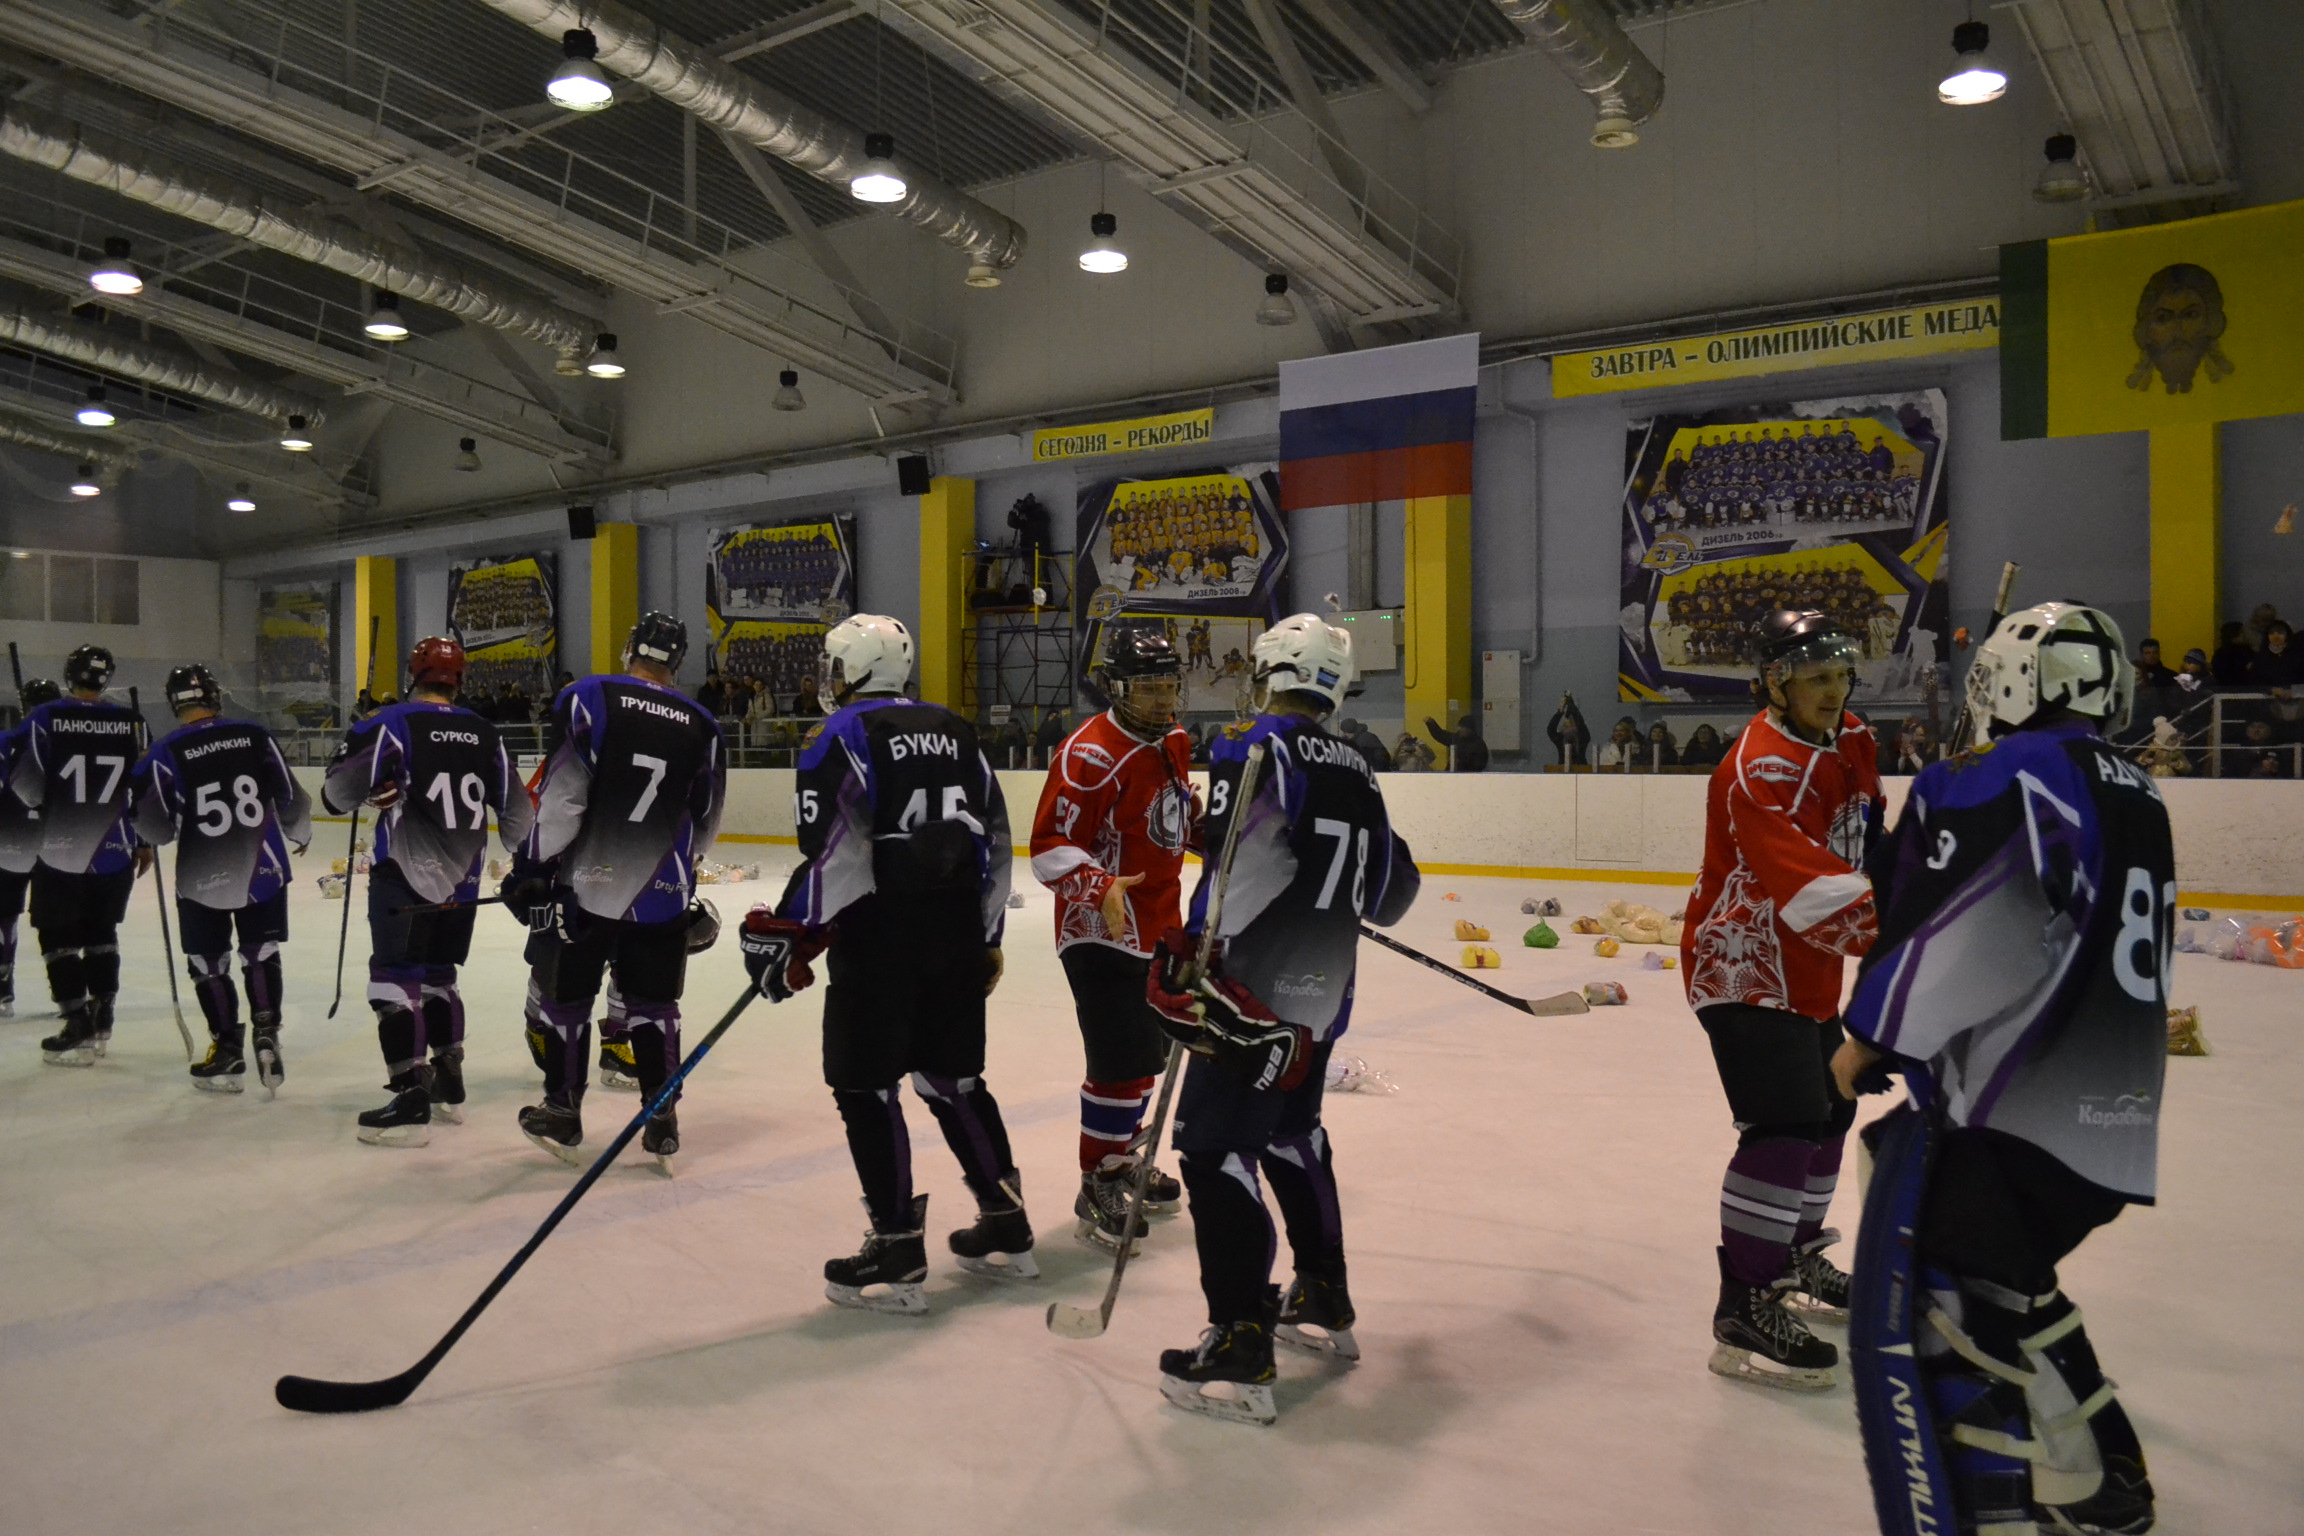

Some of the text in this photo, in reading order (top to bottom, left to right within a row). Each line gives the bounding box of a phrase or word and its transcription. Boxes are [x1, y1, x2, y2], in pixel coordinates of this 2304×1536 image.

[1590, 347, 1677, 379] ЗАВТРА
[1706, 314, 1914, 364] ОЛИМПИЙСКИЕ
[1038, 433, 1107, 458] СЕГОДНЯ
[1127, 419, 1210, 448] РЕКОРДЫ
[1701, 533, 1744, 547] ДИЗЕЛЬ
[1746, 530, 1775, 541] 2006
[1187, 588, 1218, 599] ДИЗЕЛЬ
[1219, 587, 1239, 596] 2008
[52, 718, 131, 735] ПАНЮШКИН
[620, 696, 691, 726] ТРУШКИН
[184, 736, 252, 761] БЫЛИЧКИН
[429, 730, 480, 745] СУРКОВ
[888, 732, 959, 761] БУКИН
[59, 754, 126, 804] 17
[627, 753, 668, 823] 7
[196, 774, 265, 838] 58
[425, 772, 486, 831] 19
[1314, 817, 1370, 917] 78
